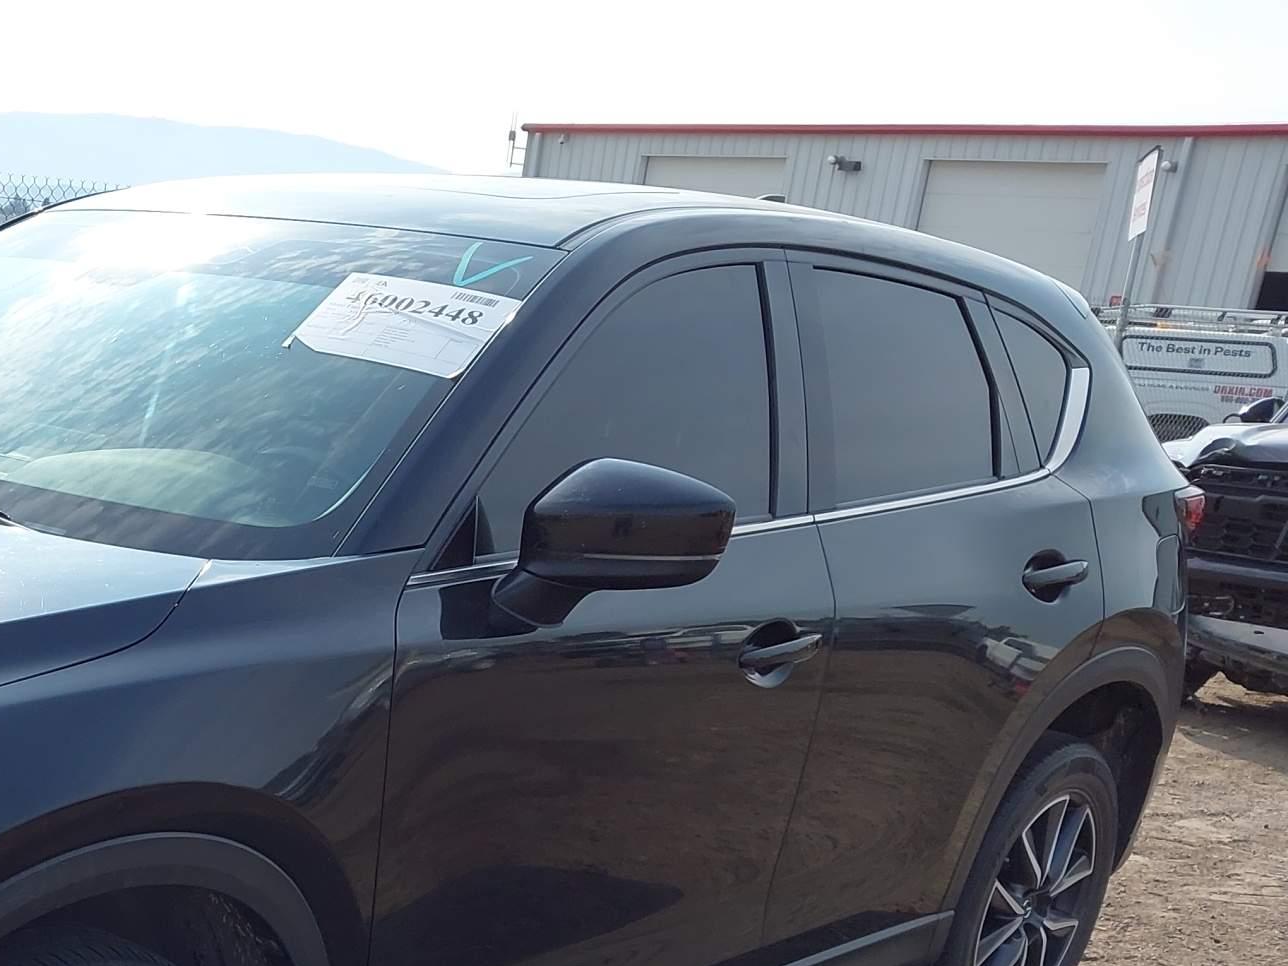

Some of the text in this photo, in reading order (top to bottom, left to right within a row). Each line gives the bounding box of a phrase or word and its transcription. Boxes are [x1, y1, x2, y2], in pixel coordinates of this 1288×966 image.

[1138, 342, 1252, 358] The Best in Pests
